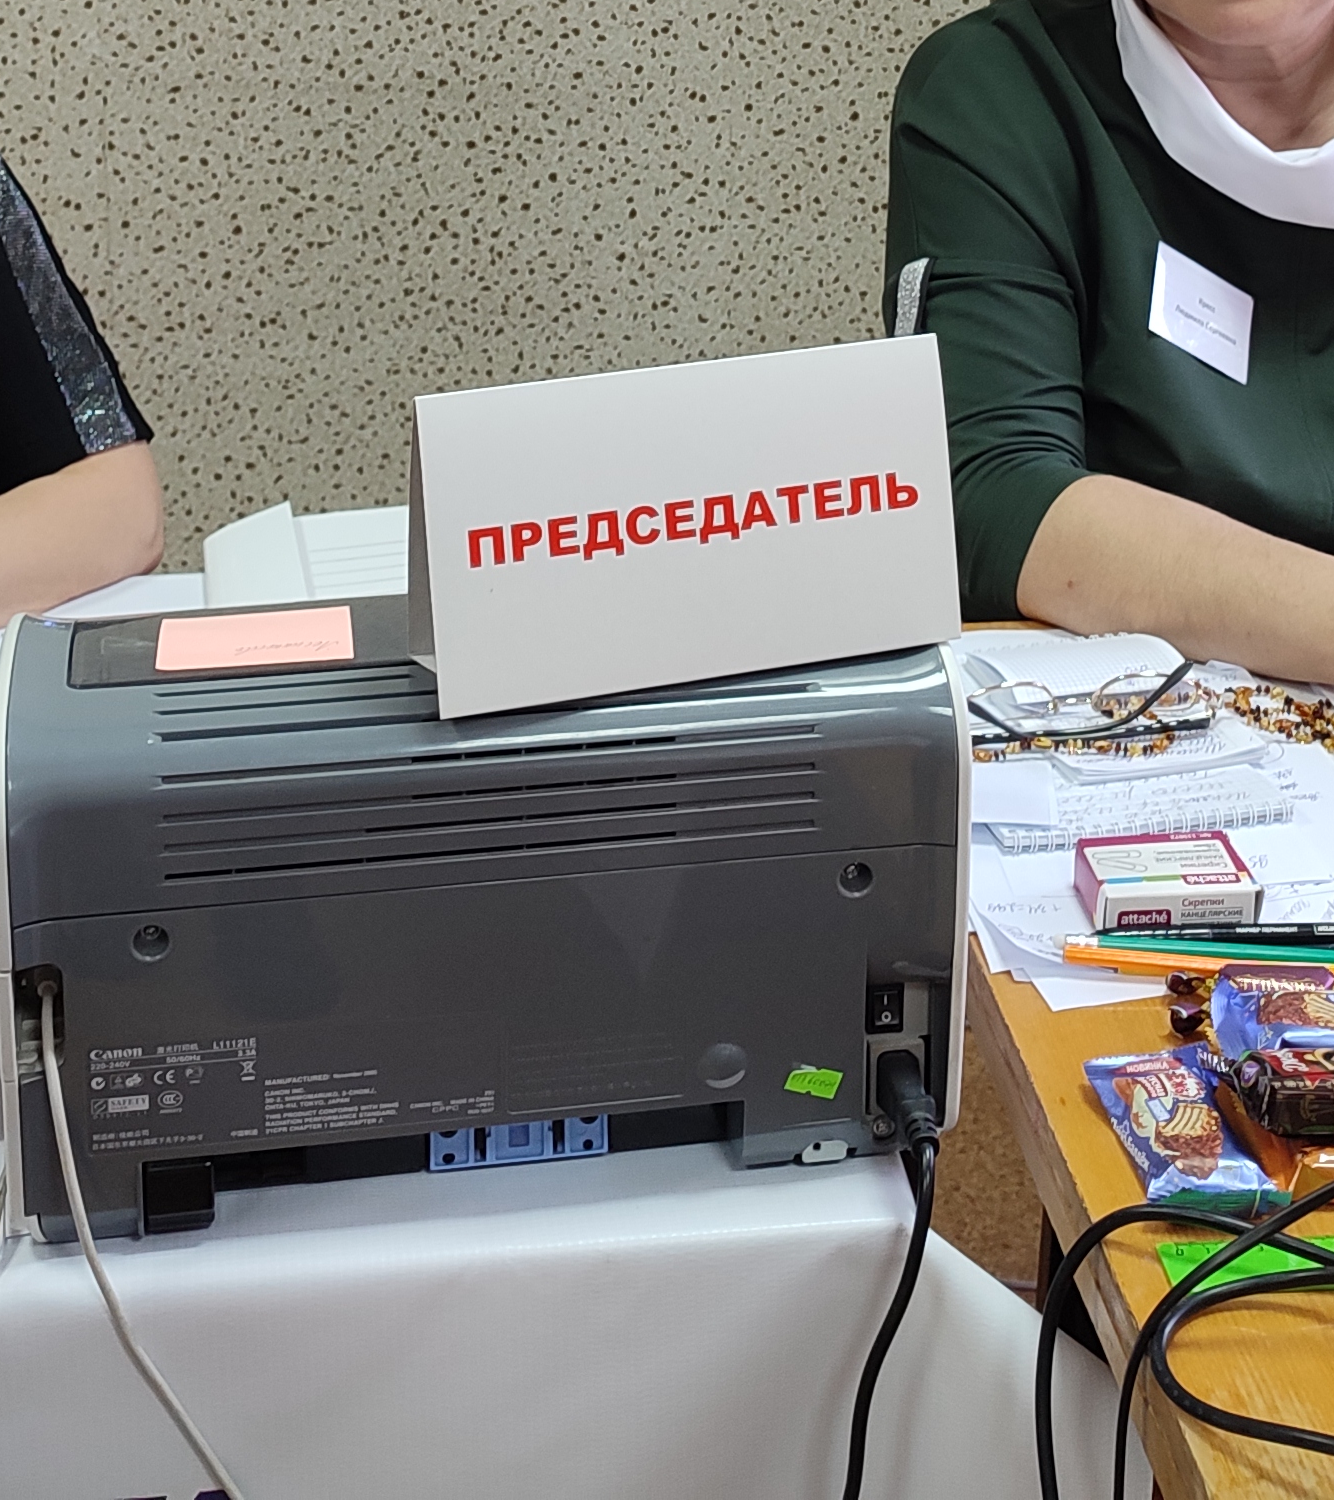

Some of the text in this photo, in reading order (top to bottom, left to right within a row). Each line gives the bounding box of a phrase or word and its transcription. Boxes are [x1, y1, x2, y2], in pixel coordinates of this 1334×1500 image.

[467, 471, 920, 569] ПРЕДСЕДАТЕЛЬ
[1186, 875, 1236, 884] attaché
[1181, 898, 1225, 909] Скрепки
[1120, 911, 1168, 925] attaché
[1180, 908, 1244, 918] КАНЦЕЛЯРСКИЕ
[213, 1037, 257, 1050] L11121E
[89, 1047, 143, 1061] Canon
[90, 1061, 131, 1070] 220-240V
[1126, 1060, 1170, 1073] НОВИНКА
[264, 1073, 331, 1086] MANUFACTURED:
[282, 1109, 317, 1119] PRODUCT
[318, 1106, 359, 1116] CONFORMS
[265, 1118, 303, 1127] RADIATION
[304, 1113, 357, 1124] PERFORMANCE
[289, 1123, 323, 1132] CHAPTER
[329, 1117, 377, 1128] SUBCHAPTER
